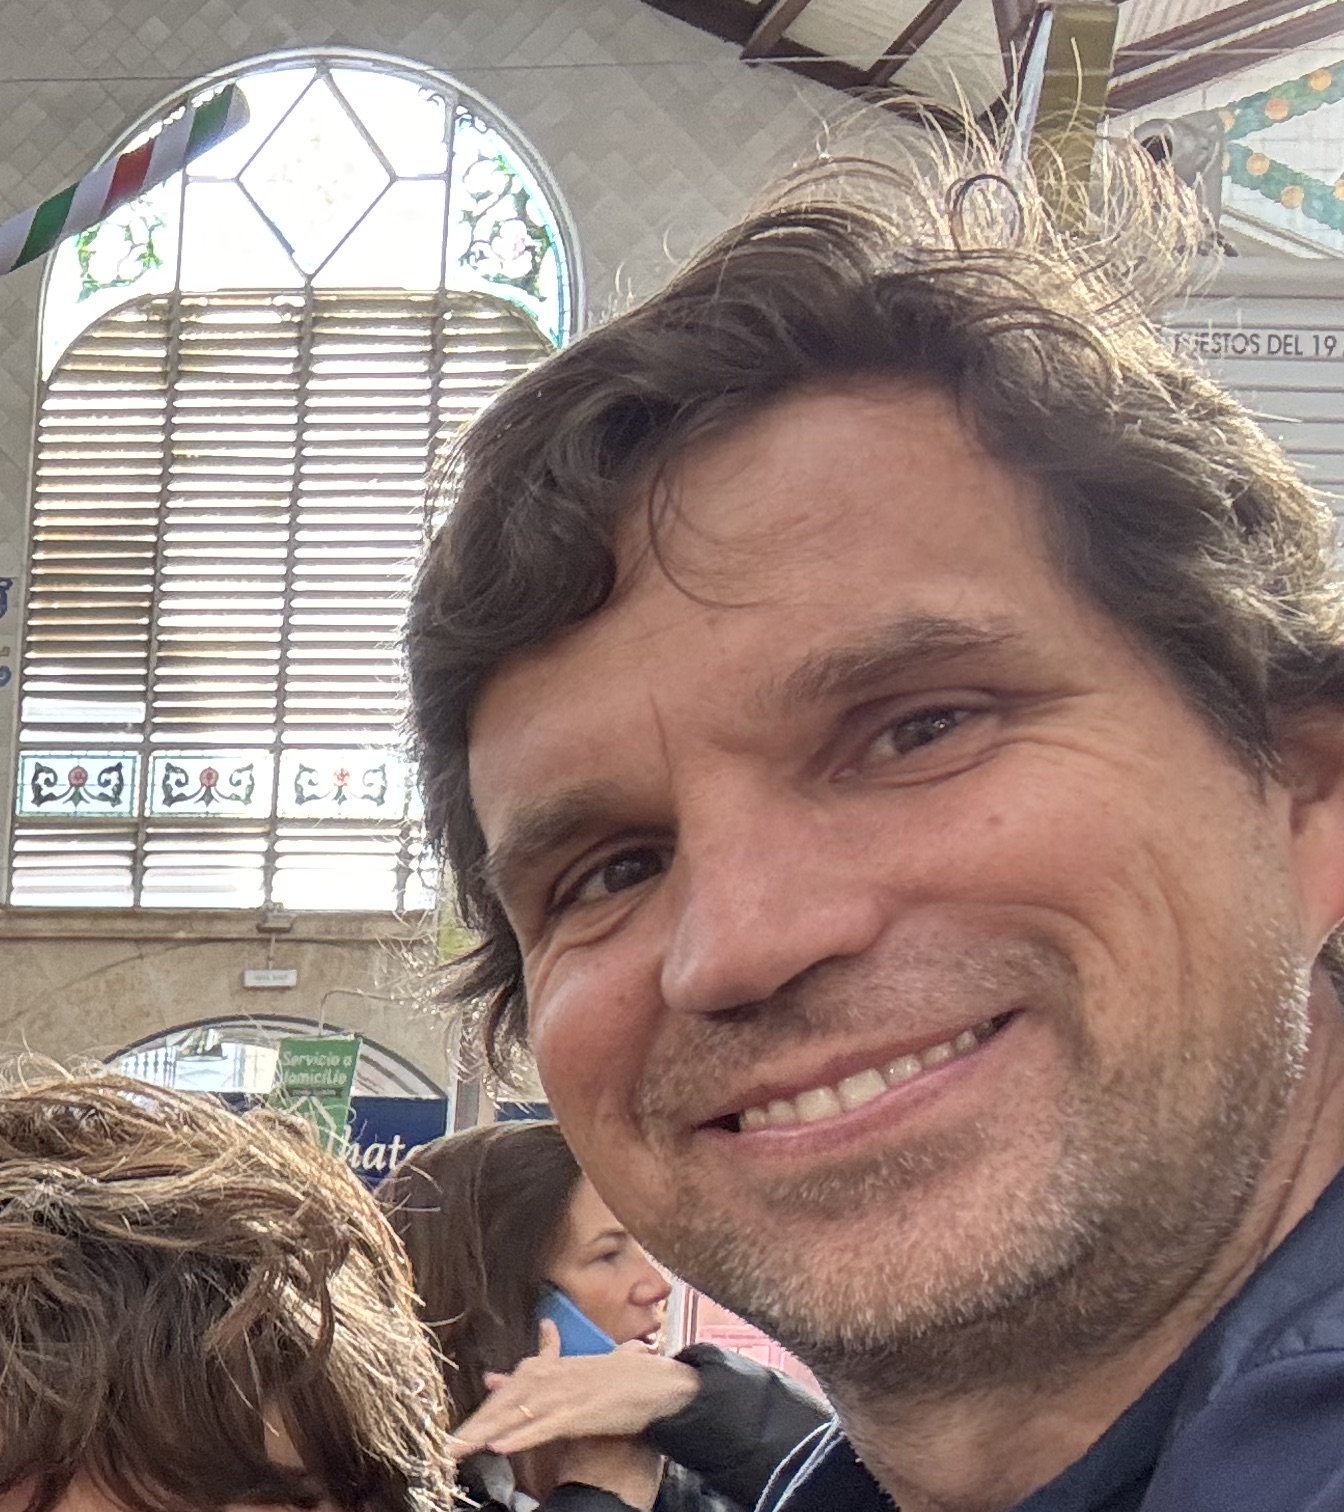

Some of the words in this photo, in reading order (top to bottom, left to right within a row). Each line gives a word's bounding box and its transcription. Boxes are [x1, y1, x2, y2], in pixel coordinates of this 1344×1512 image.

[1267, 334, 1304, 356] DEL
[1312, 334, 1337, 357] 19
[283, 1051, 340, 1067] Servicio
